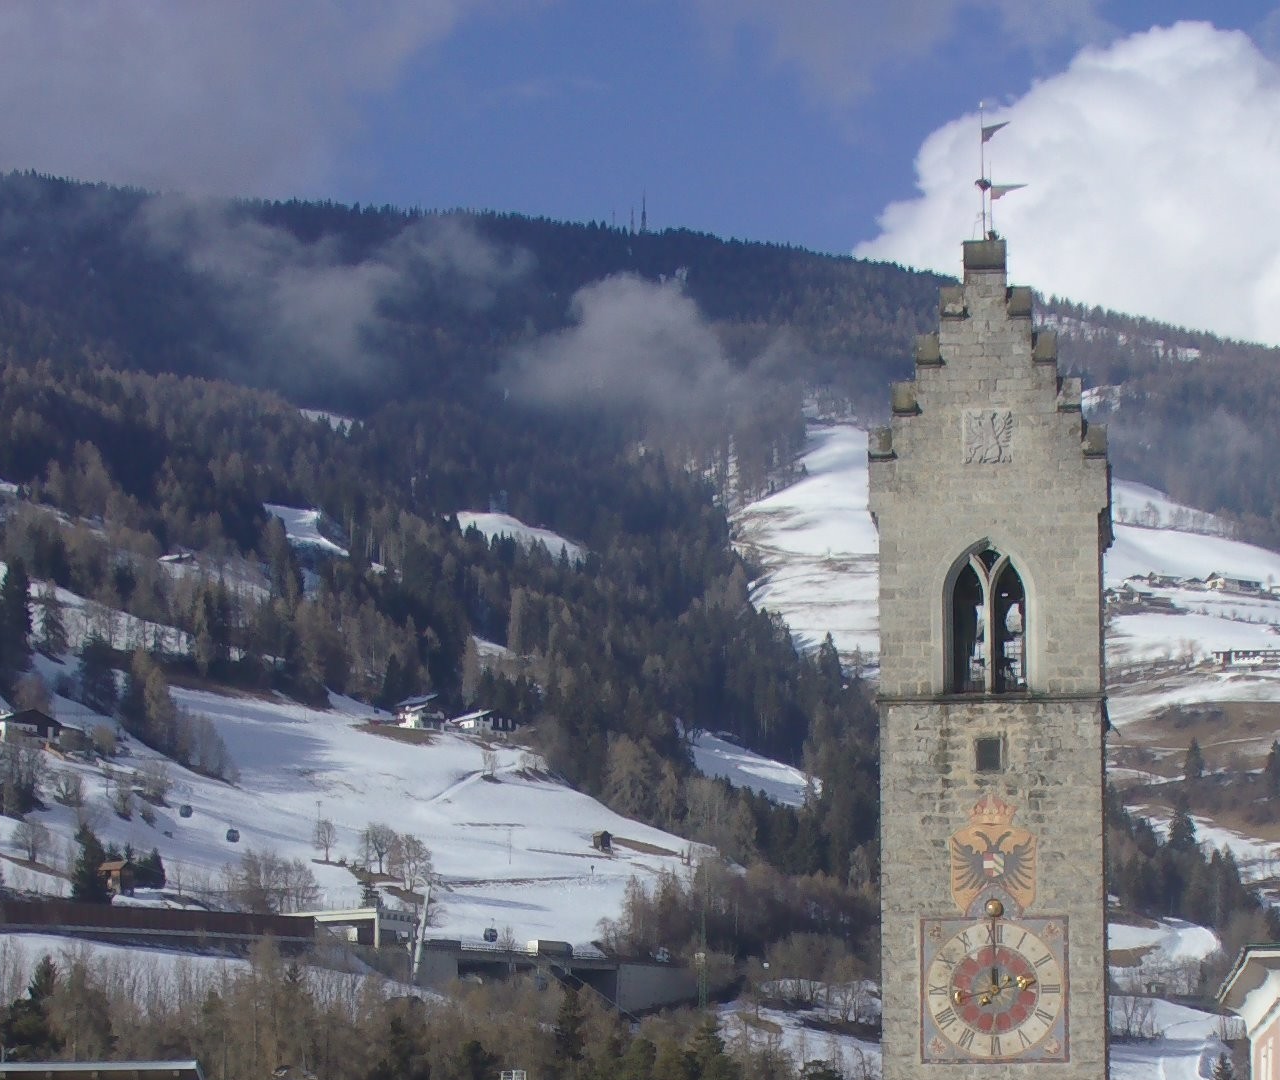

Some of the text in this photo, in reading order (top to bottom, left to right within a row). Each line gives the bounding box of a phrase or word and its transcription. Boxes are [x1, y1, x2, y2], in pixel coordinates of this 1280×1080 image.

[1033, 953, 1053, 968] II
[1041, 984, 1060, 993] III
[1018, 1029, 1032, 1048] V
